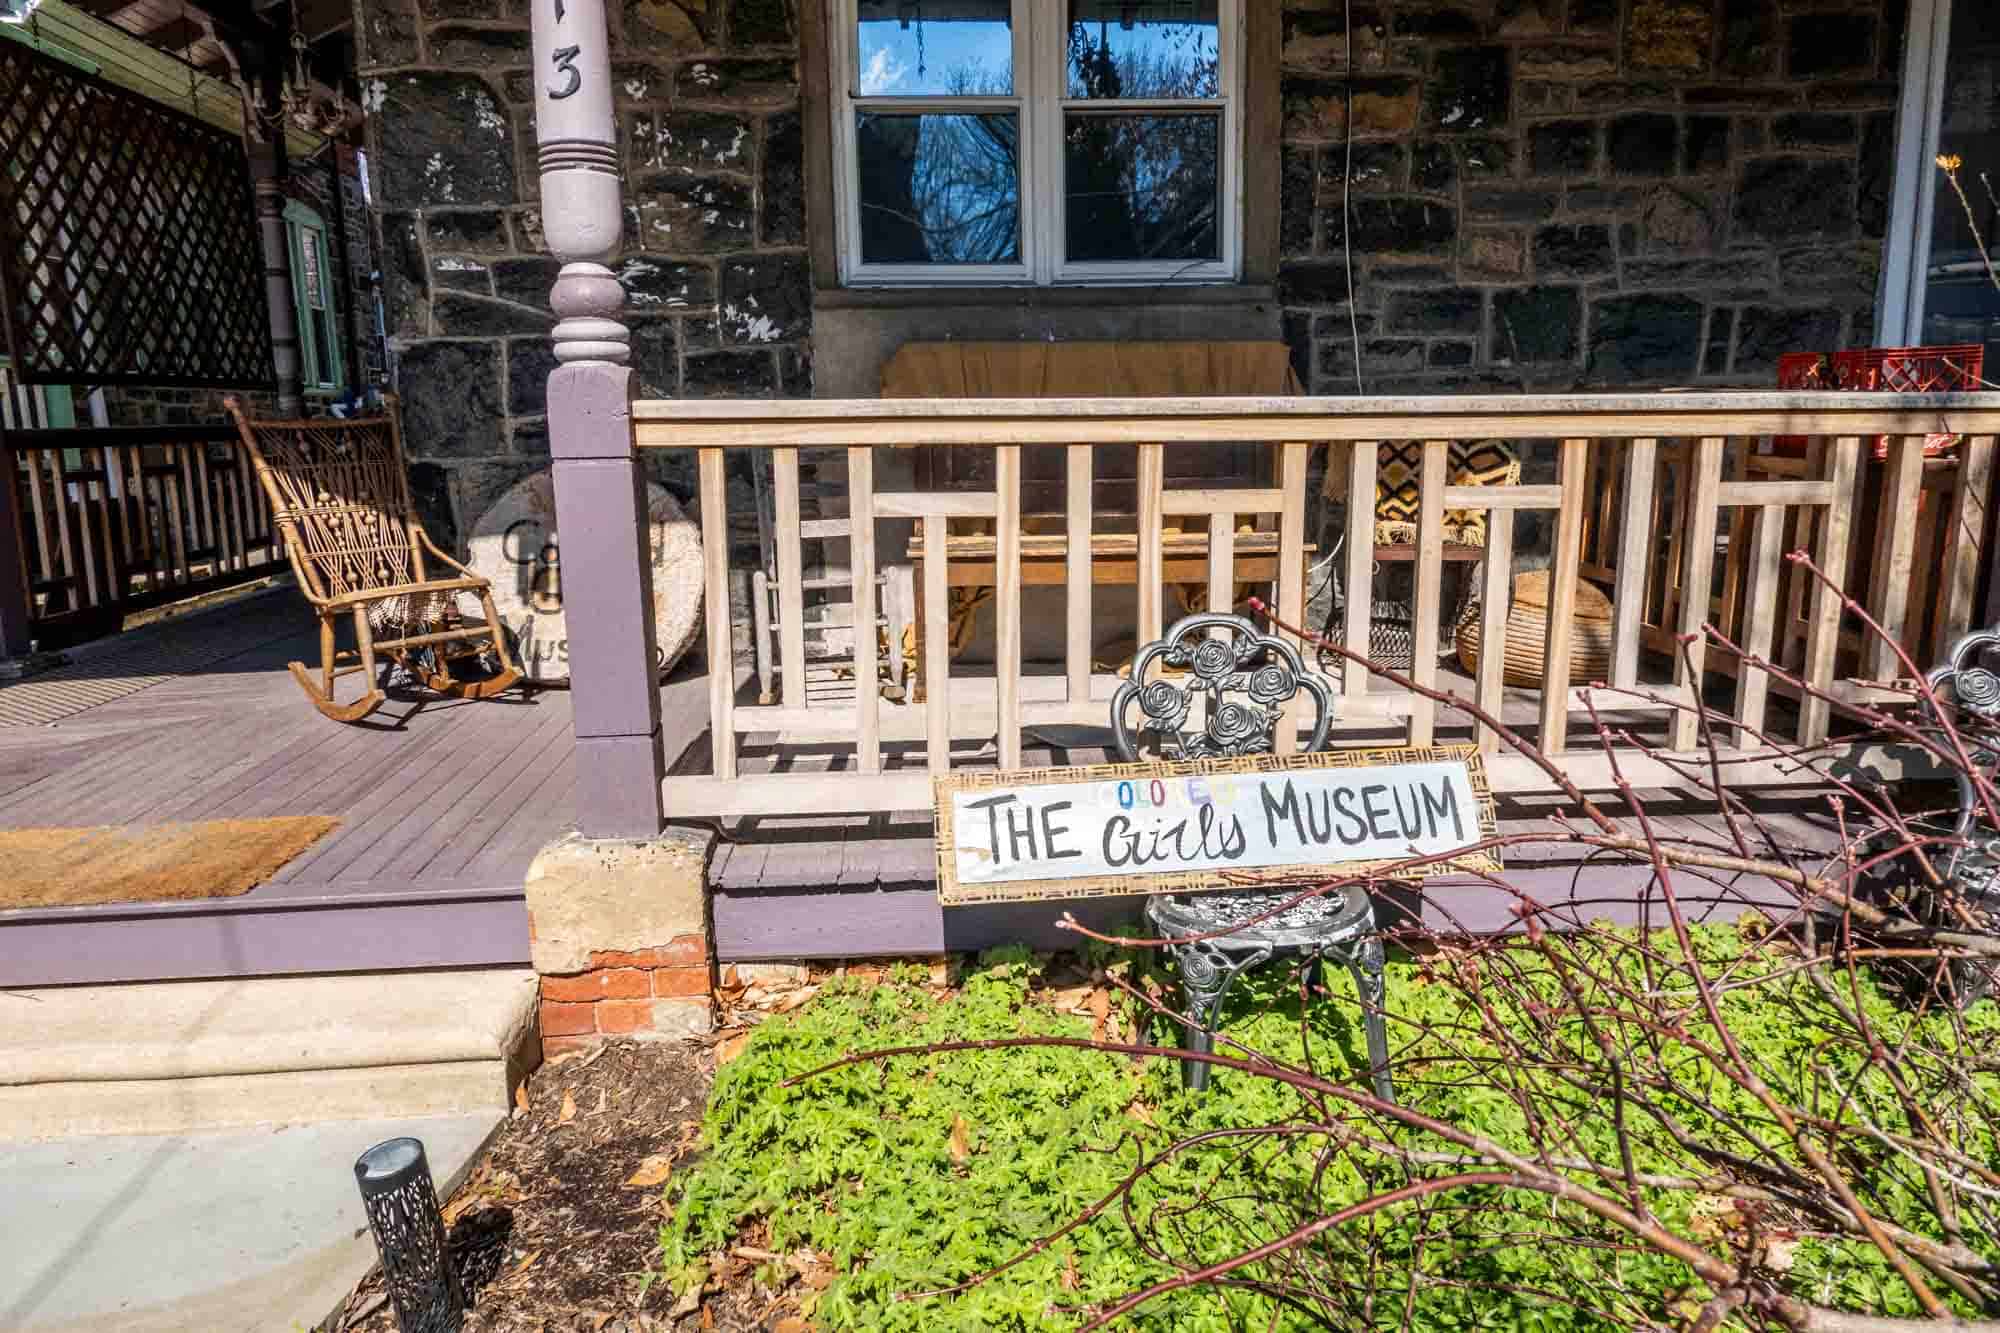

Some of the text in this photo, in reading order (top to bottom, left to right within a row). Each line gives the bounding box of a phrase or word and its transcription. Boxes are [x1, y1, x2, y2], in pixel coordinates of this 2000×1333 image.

[963, 775, 1464, 867] THE Girls MUSEUM
